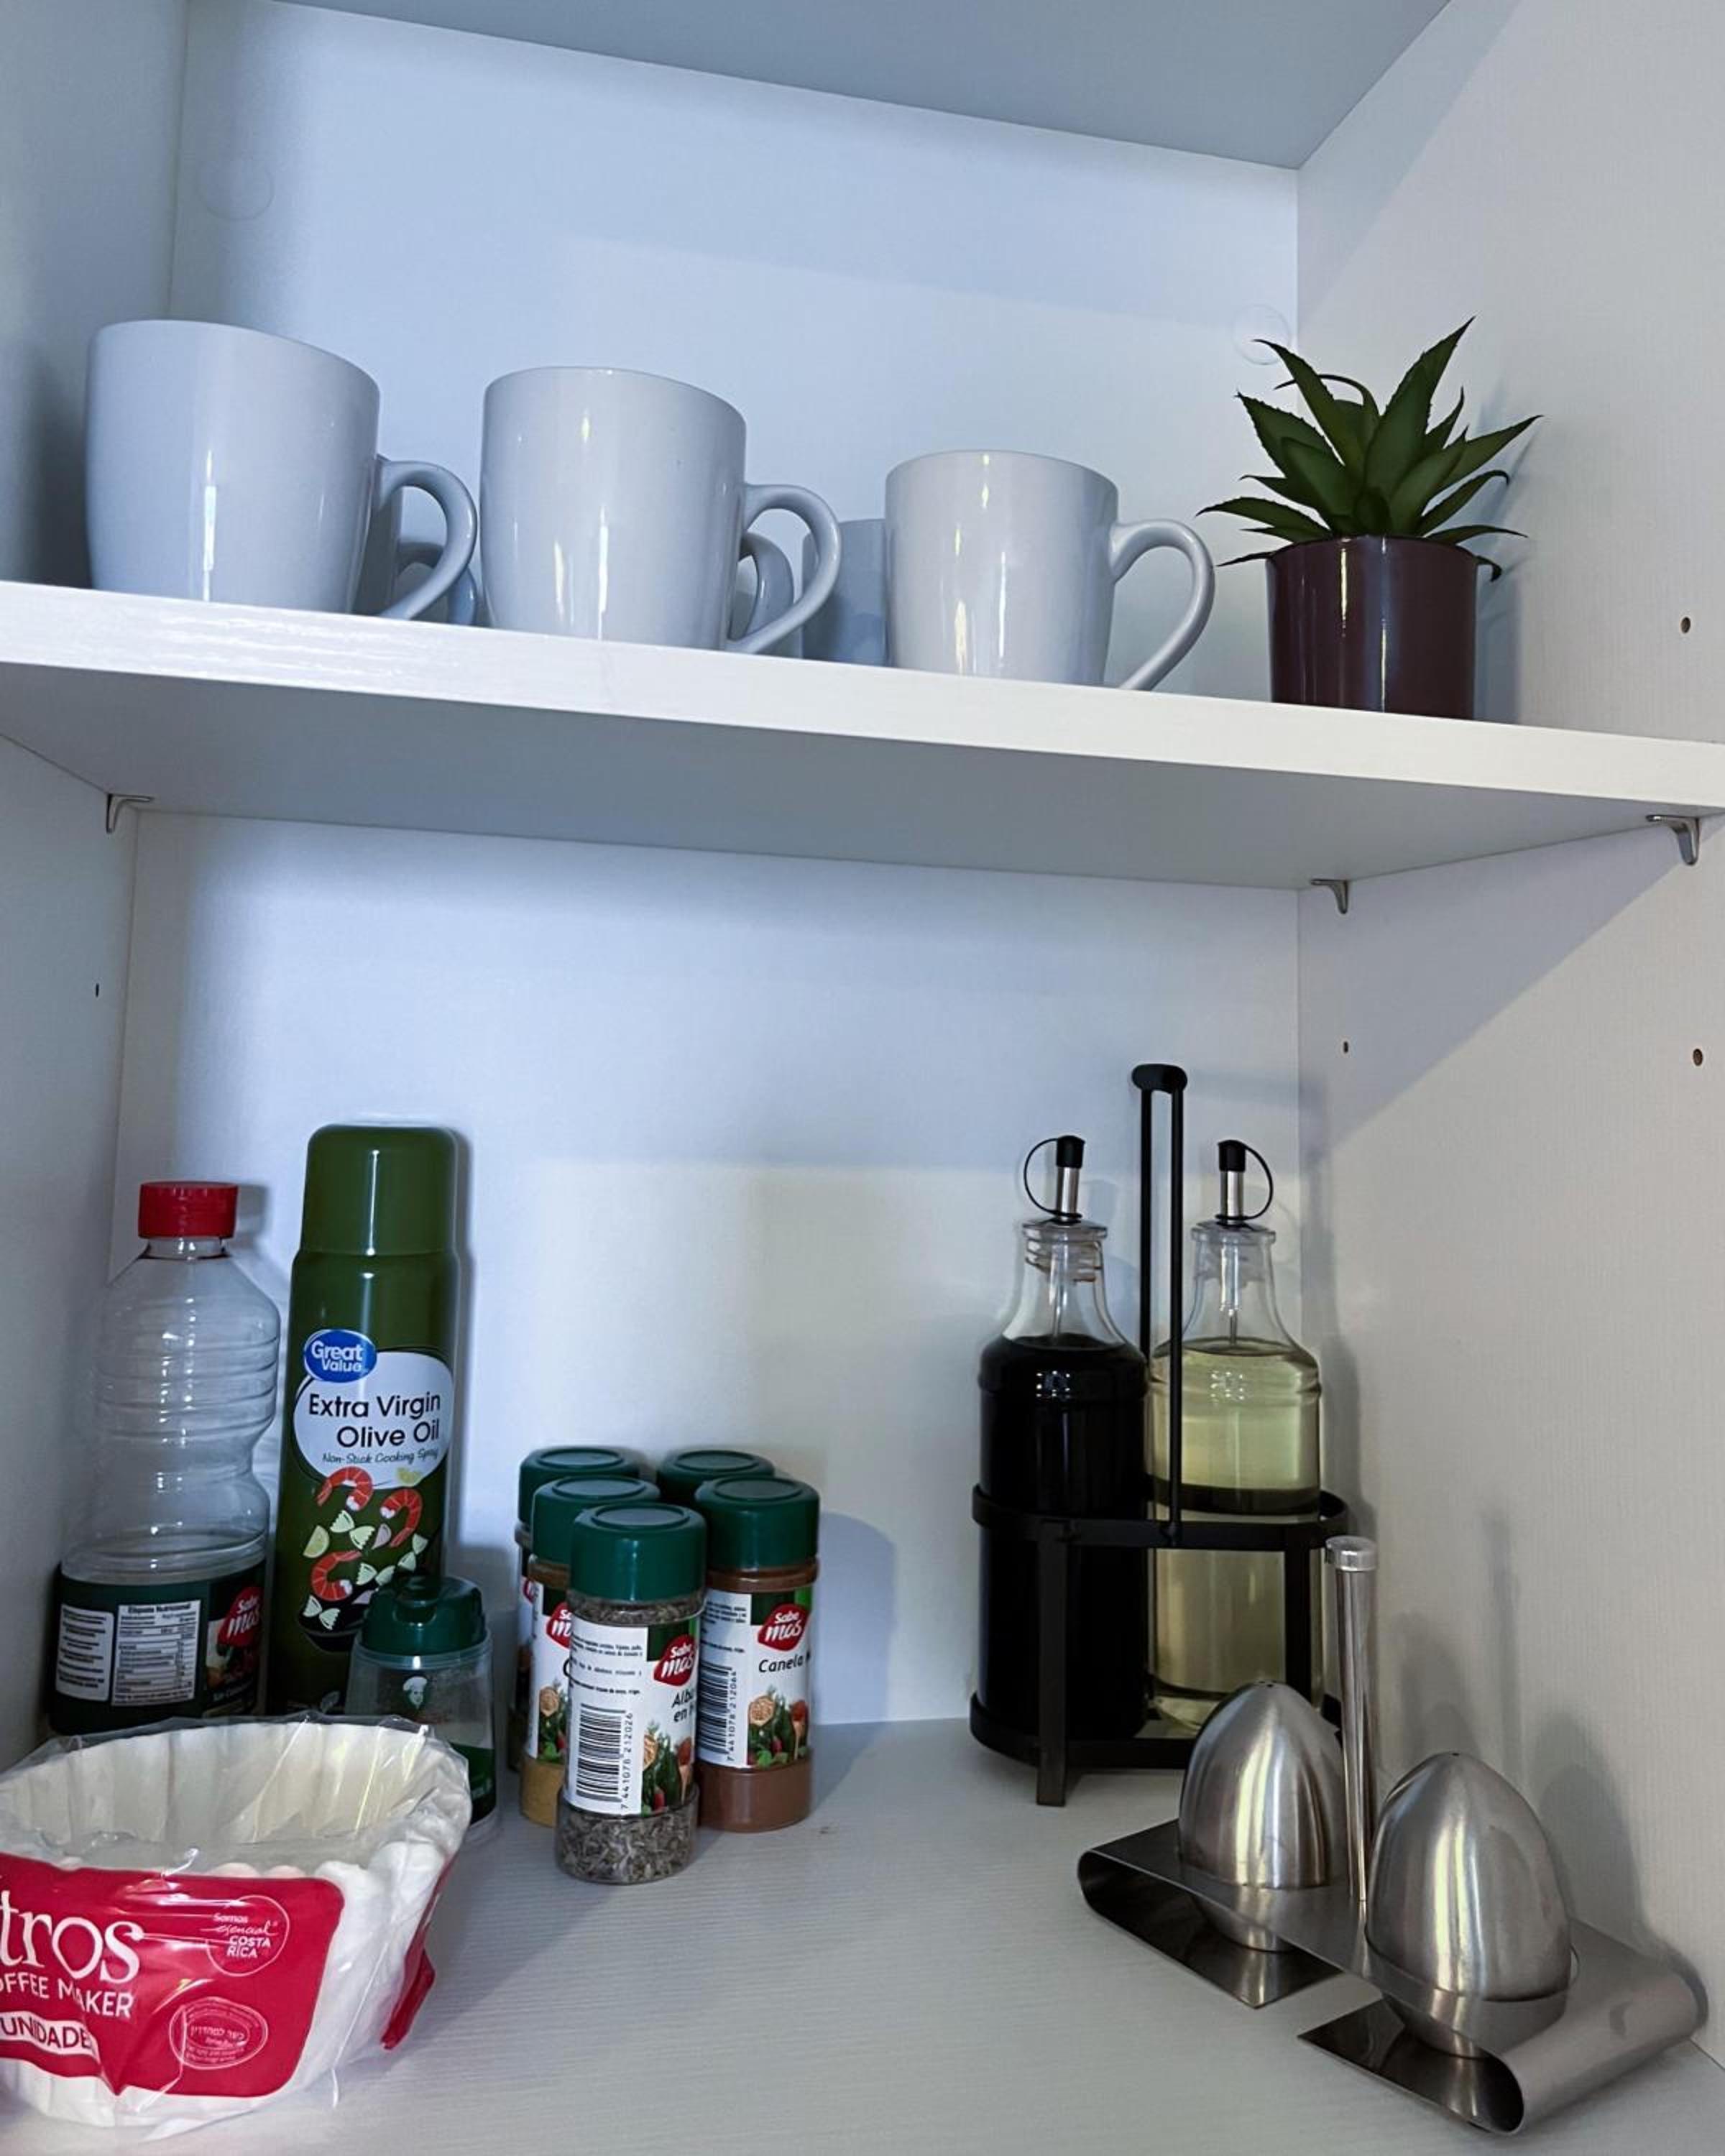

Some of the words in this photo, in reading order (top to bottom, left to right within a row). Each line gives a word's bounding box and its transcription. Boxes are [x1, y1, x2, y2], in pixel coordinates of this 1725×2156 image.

[311, 1340, 363, 1361] Great
[321, 1358, 362, 1372] Value
[309, 1393, 369, 1417] Extra
[376, 1391, 441, 1420] Virgin
[337, 1426, 405, 1448] Olive
[413, 1419, 440, 1443] Oil
[374, 1452, 415, 1465] Cooking
[758, 1654, 804, 1673] Canela
[673, 1709, 688, 1723] en
[229, 1935, 271, 1948] COSTA
[226, 1945, 258, 1958] RICA
[0, 1971, 50, 1999] FFEE
[58, 1978, 134, 2018] MAKER
